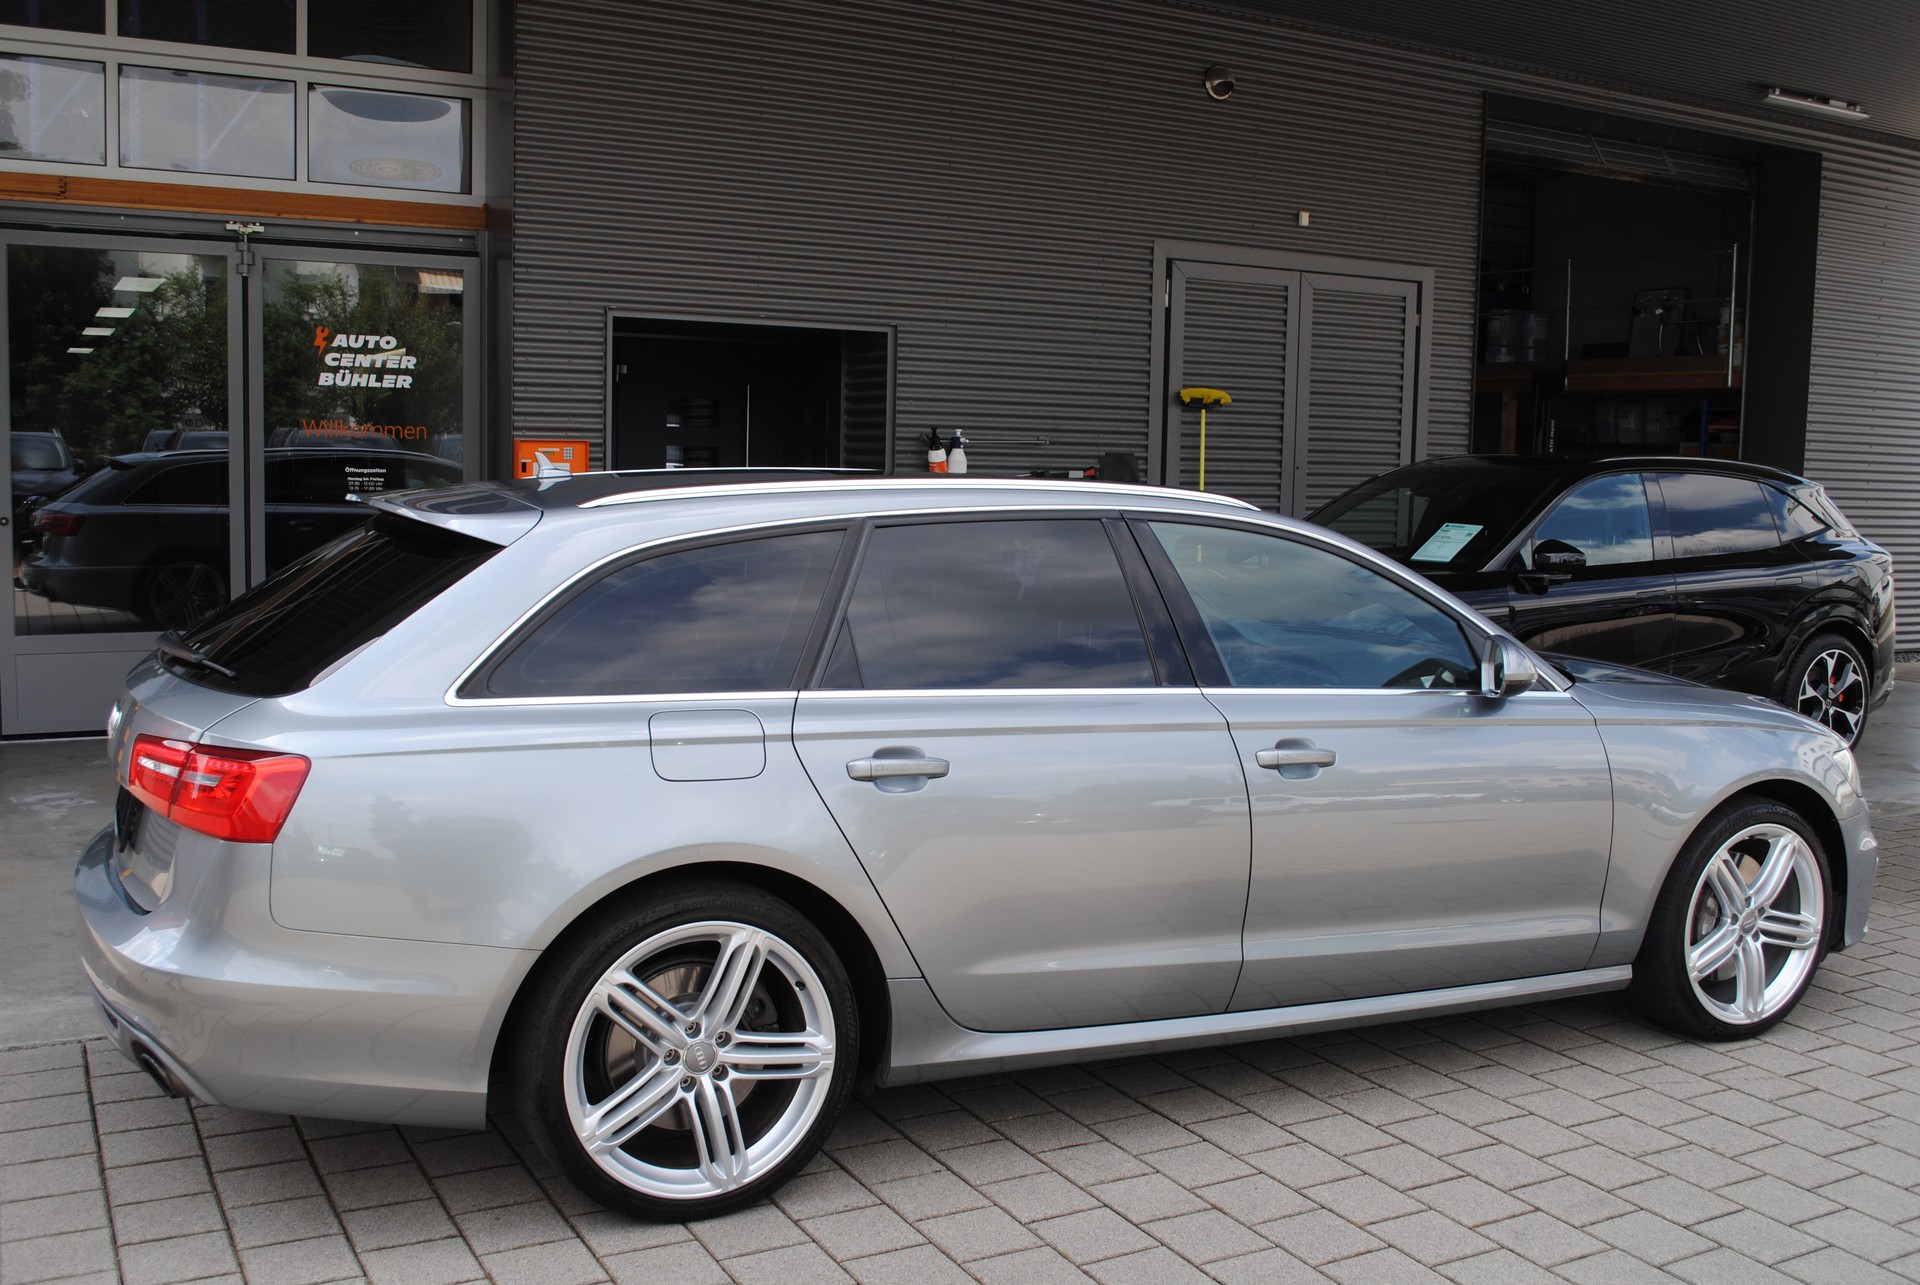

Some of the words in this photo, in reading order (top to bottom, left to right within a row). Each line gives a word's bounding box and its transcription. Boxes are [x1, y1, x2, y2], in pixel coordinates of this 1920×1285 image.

[331, 333, 397, 350] AUTO
[324, 352, 417, 369] CENTER
[318, 369, 413, 388] BÜHLER
[303, 419, 428, 440] Willkommen
